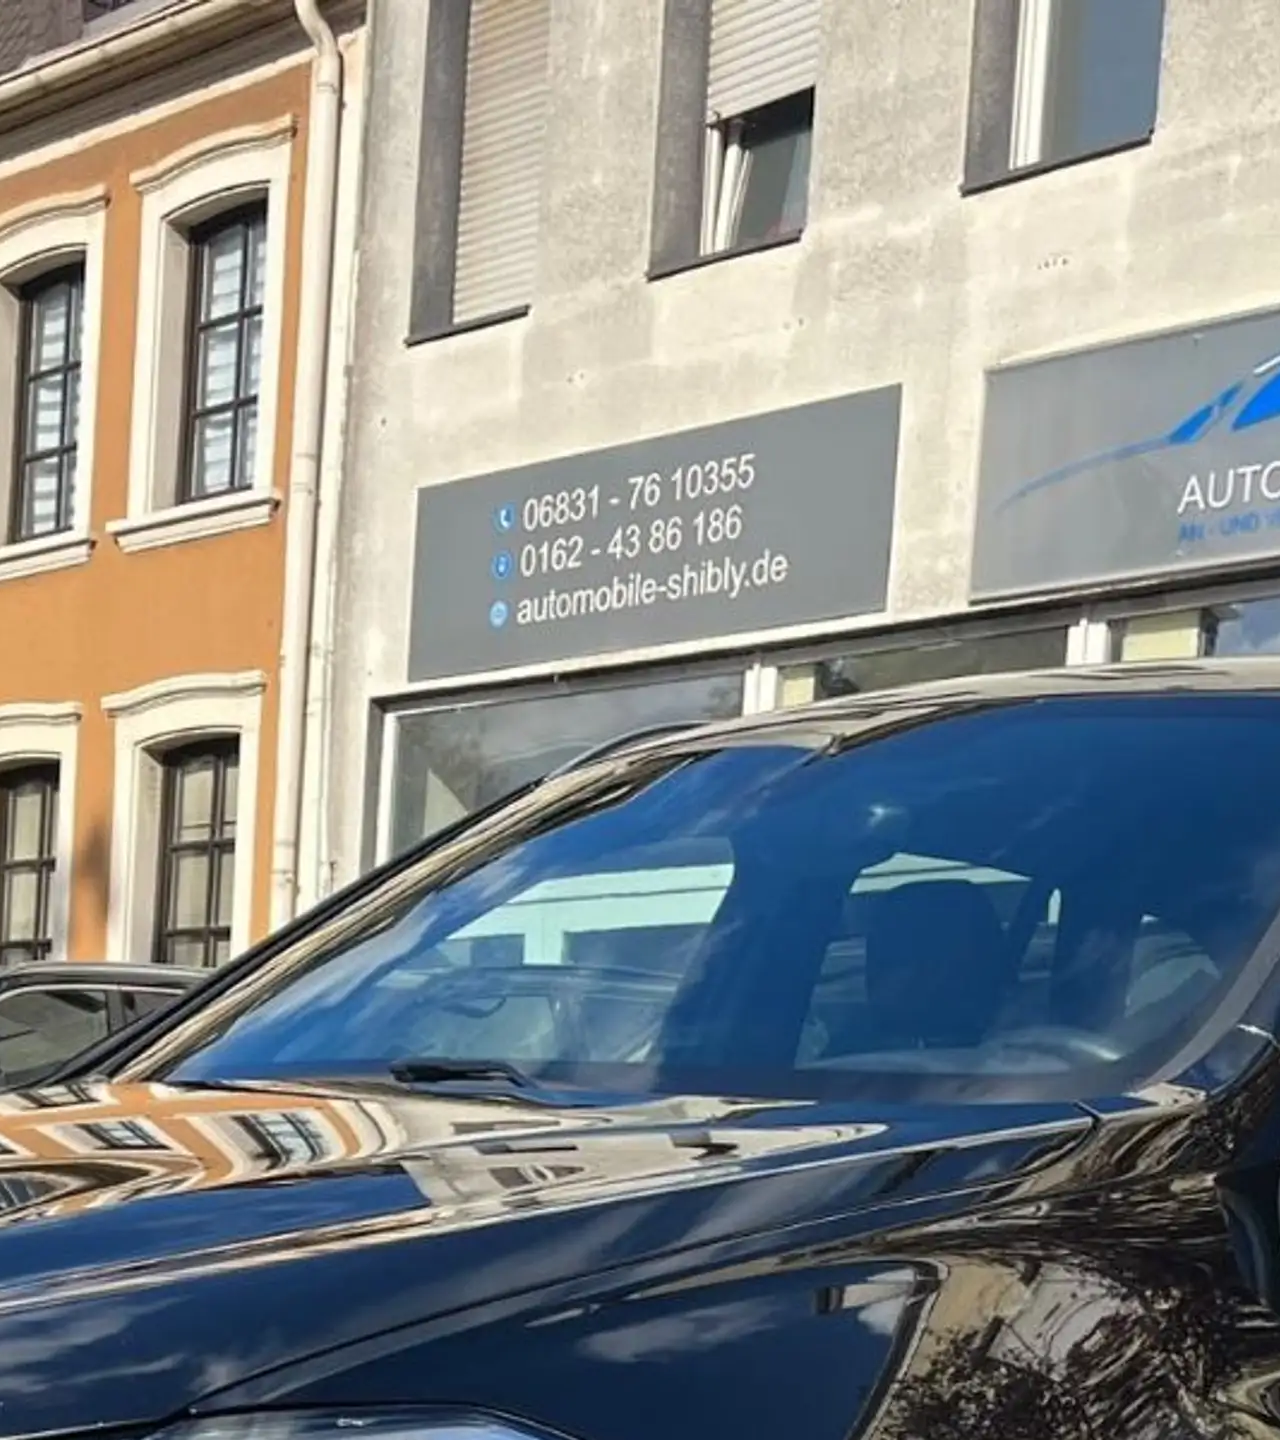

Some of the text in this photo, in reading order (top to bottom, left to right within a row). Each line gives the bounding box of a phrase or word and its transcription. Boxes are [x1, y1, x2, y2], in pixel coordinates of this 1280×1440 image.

[523, 485, 599, 531] 06831
[628, 472, 661, 510] 76
[671, 453, 756, 501] 10355
[520, 535, 583, 577] 0162
[607, 524, 641, 560] 43
[648, 516, 682, 553] 86
[693, 504, 743, 546] 186
[516, 548, 788, 625] automobile-shibly.de
